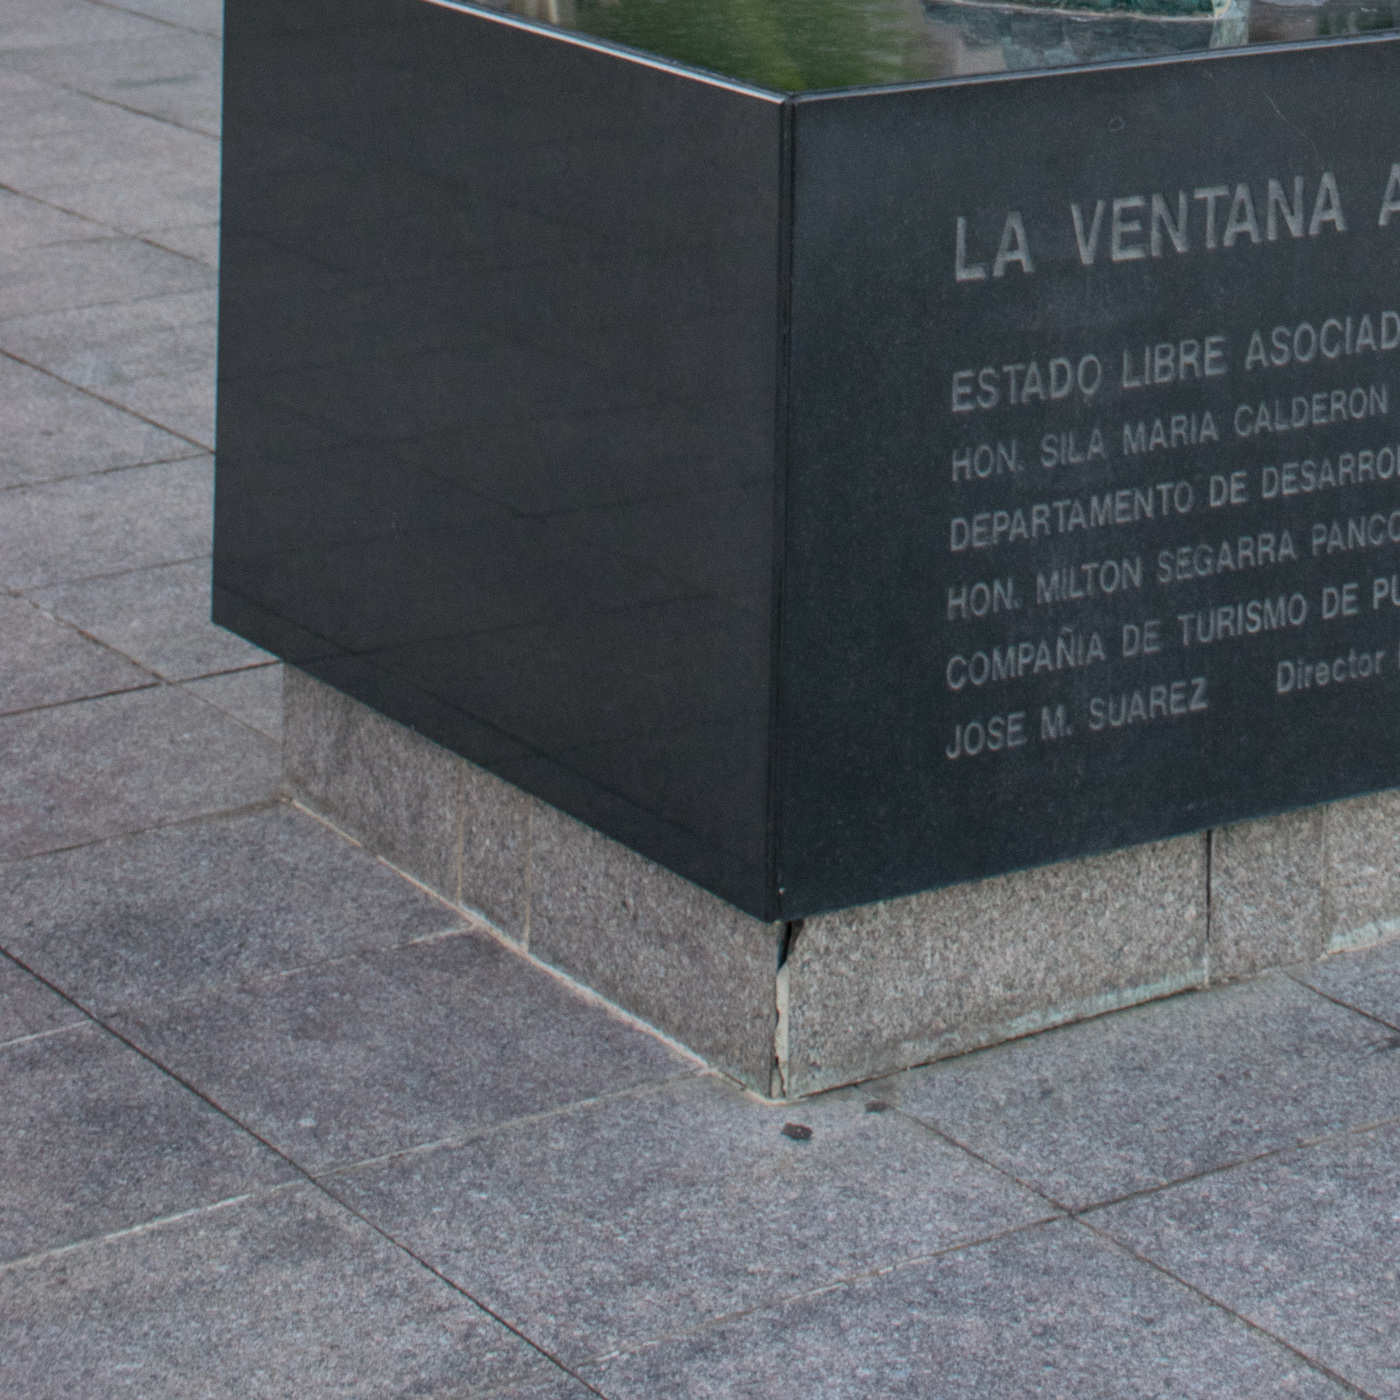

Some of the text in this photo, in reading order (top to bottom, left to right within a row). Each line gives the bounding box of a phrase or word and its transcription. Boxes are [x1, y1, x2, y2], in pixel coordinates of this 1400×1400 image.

[955, 214, 1035, 281] LA
[1071, 171, 1347, 266] VENTANA
[952, 353, 1101, 412] ESTADO
[1123, 335, 1227, 389] LIBRE
[952, 440, 1025, 481] HON.
[1041, 429, 1106, 468] SILA
[1123, 411, 1219, 455] MARIA
[1234, 384, 1389, 437] CALDERON
[950, 481, 1194, 551] DEPARTAMENTO
[1210, 471, 1248, 507] DE
[947, 578, 1022, 620] HON.
[1036, 557, 1143, 605] MILTON
[1157, 530, 1297, 584] SEGARRA
[946, 627, 1106, 690] COMPAÑIA
[1122, 619, 1162, 657] DE
[1178, 593, 1308, 646] TURISMO
[1322, 583, 1359, 620] DE
[945, 712, 1027, 759] JOSE
[1041, 704, 1073, 741] M.
[1088, 677, 1208, 731] SUAREZ
[1276, 648, 1384, 694] Director
